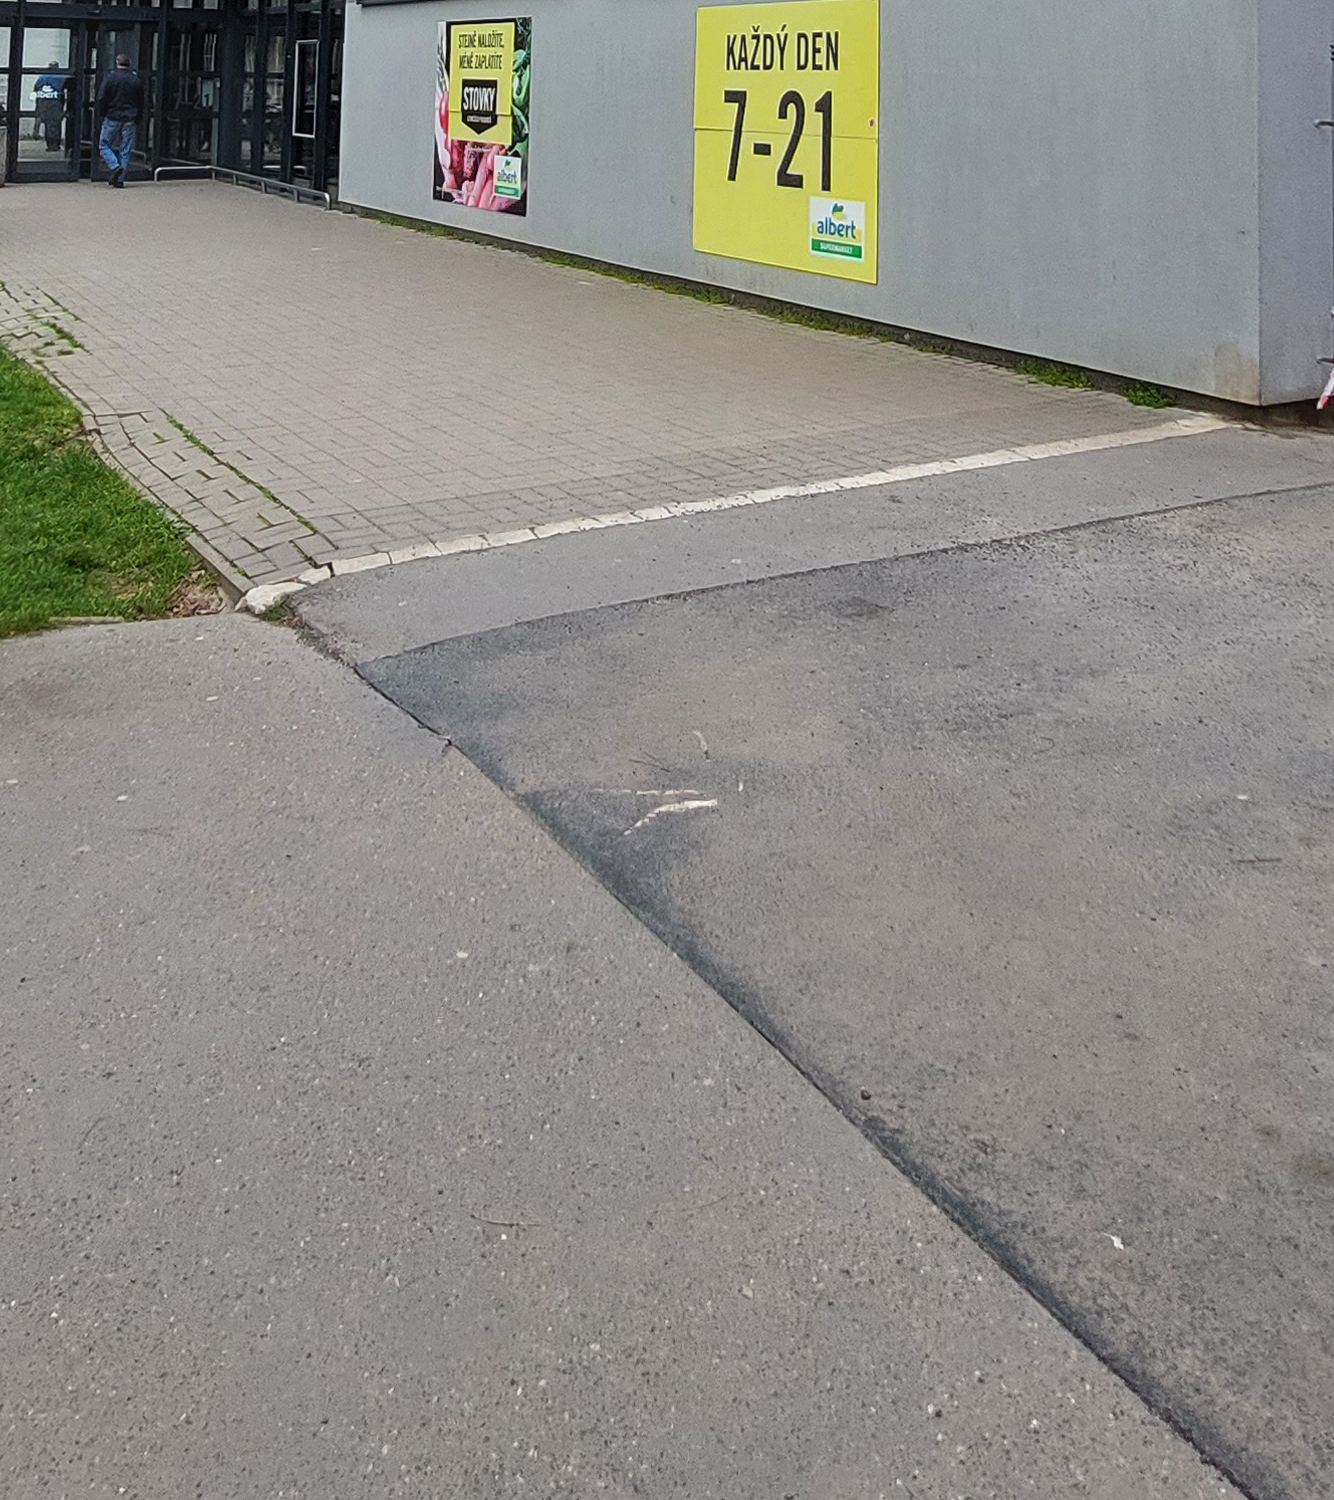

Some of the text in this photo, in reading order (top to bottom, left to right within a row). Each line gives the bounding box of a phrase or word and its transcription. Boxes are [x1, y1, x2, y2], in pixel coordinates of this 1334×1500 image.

[725, 24, 839, 71] KAŽDÝ DEN
[462, 86, 496, 112] STOVKY
[724, 89, 832, 192] 7-21
[817, 216, 856, 240] albert
